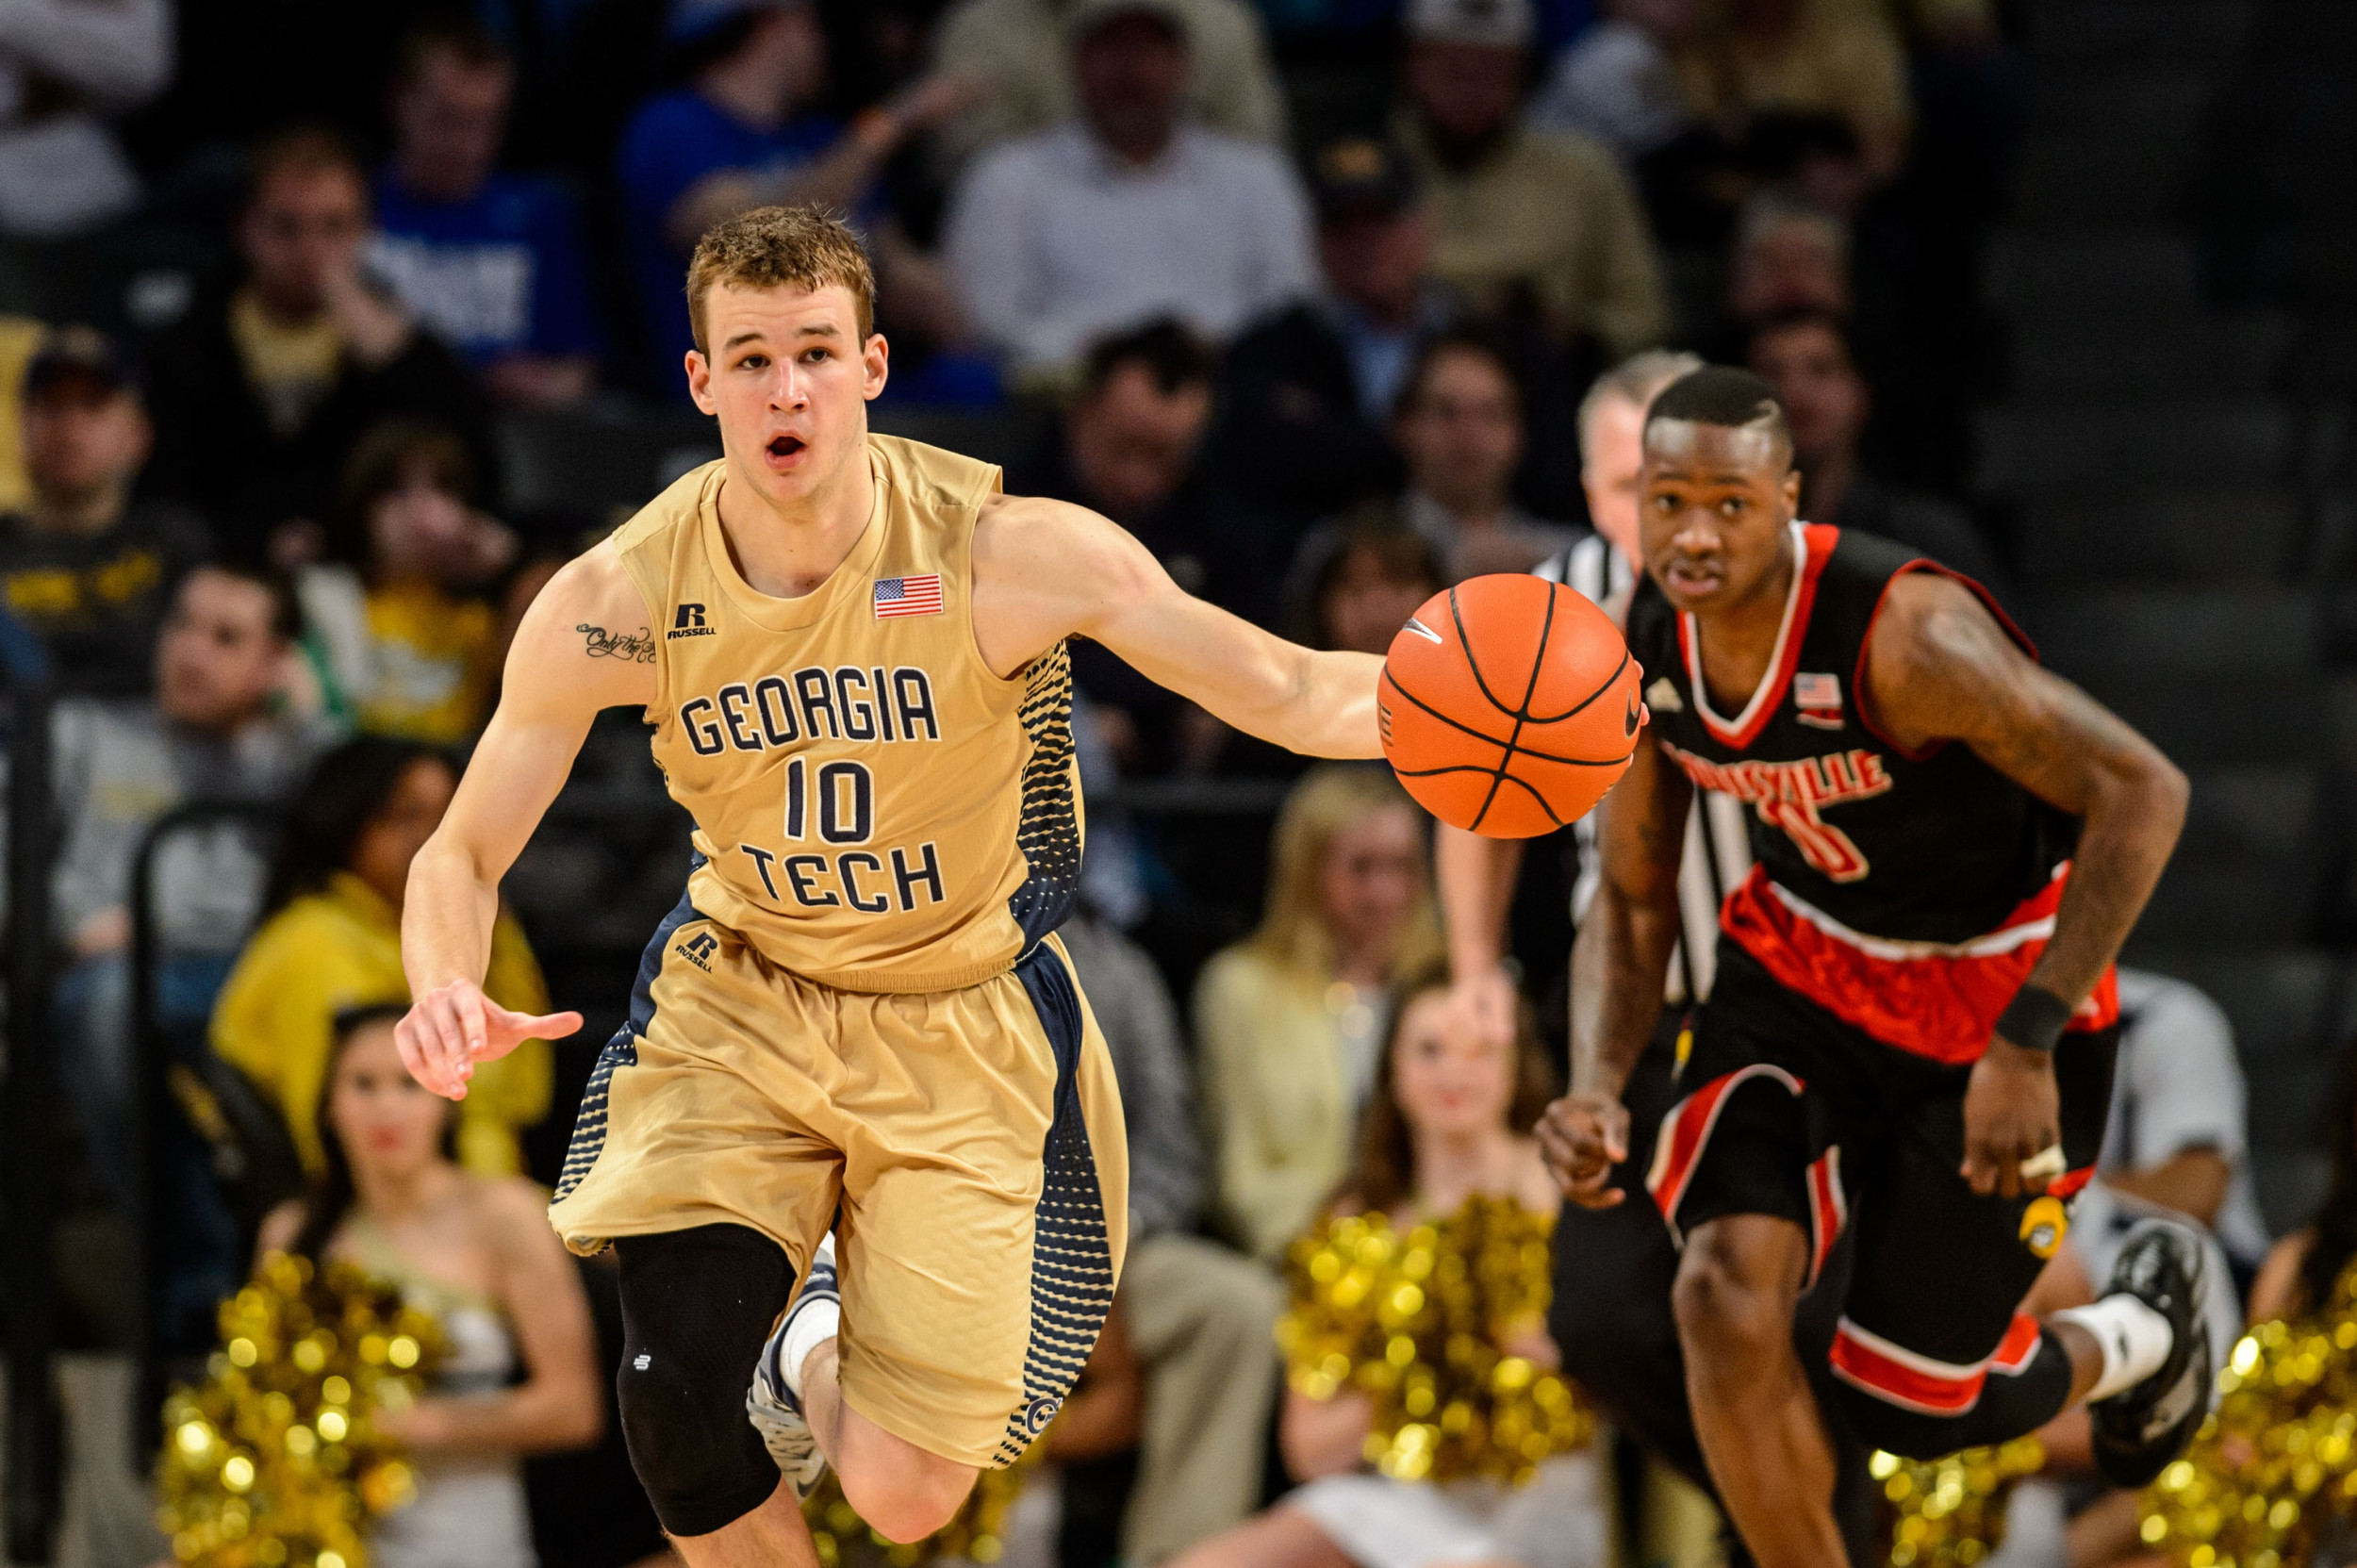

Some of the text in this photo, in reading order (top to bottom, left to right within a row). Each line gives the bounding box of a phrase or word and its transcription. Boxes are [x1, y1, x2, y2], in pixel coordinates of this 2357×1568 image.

[668, 627, 717, 639] RUSSELL
[675, 603, 706, 628] R
[680, 665, 942, 755] GEORGIA
[783, 755, 876, 847] 10
[738, 840, 947, 913] TECH
[675, 944, 713, 974] RUSSELL
